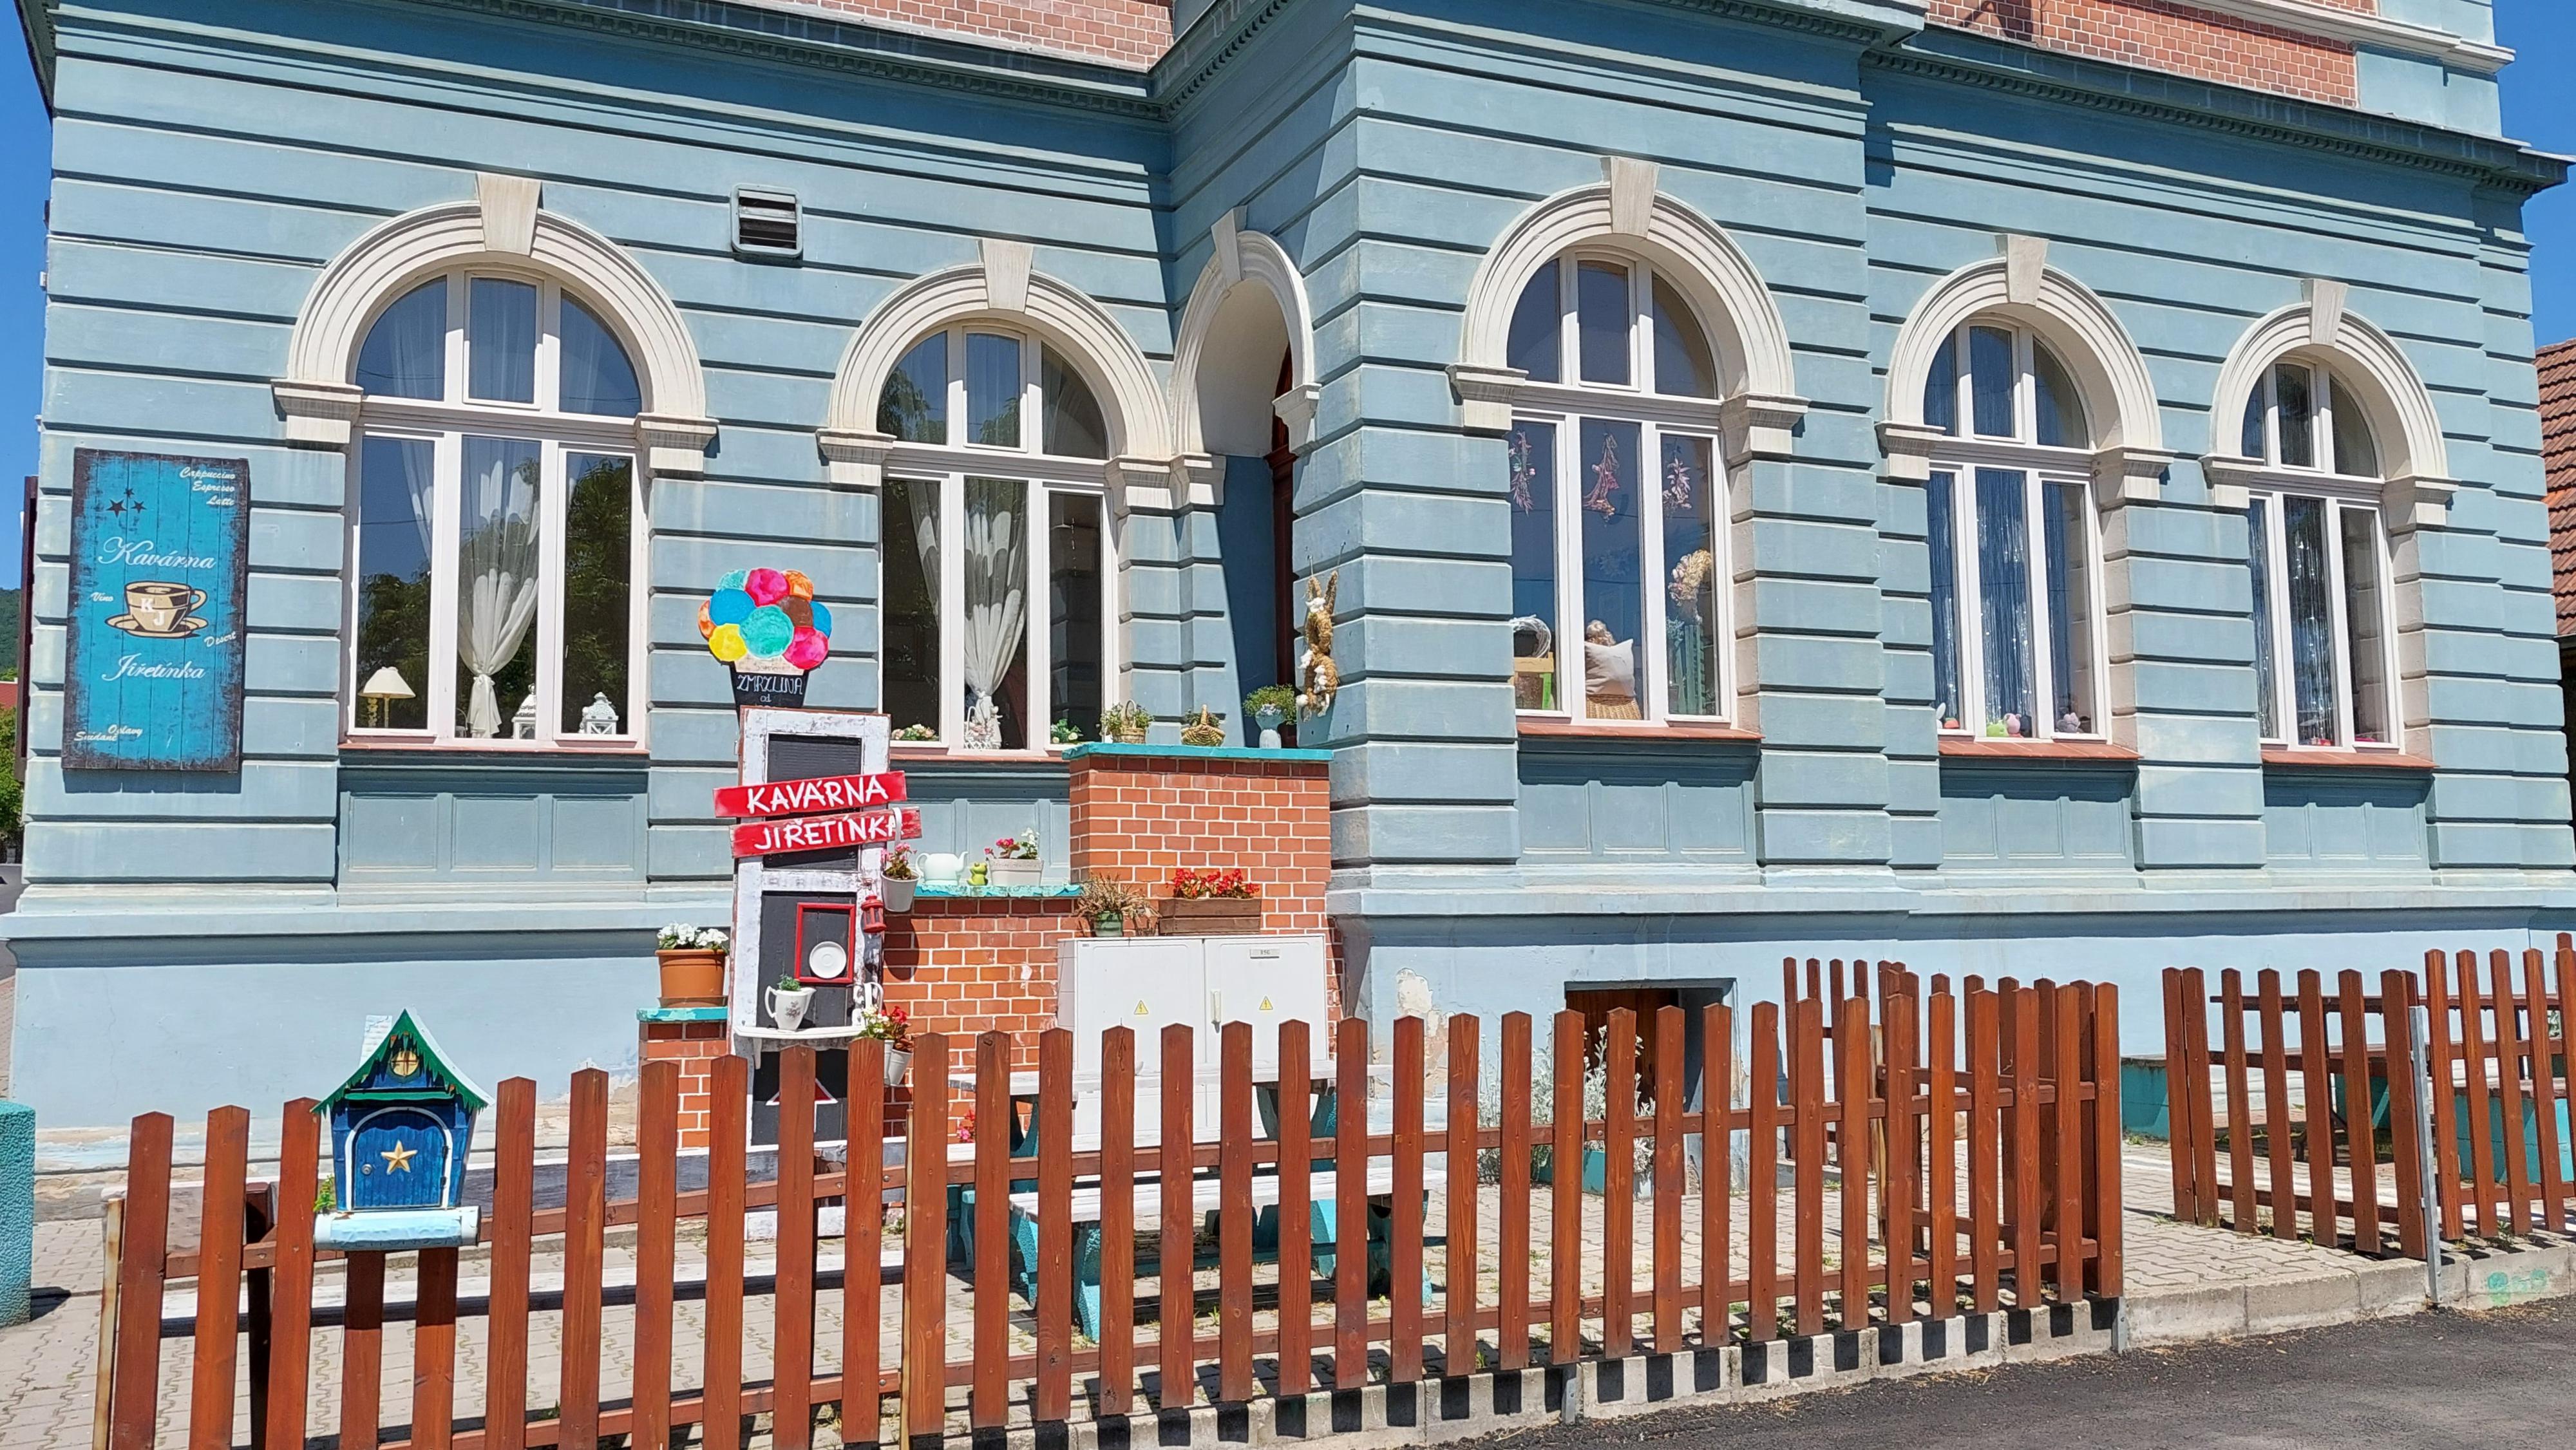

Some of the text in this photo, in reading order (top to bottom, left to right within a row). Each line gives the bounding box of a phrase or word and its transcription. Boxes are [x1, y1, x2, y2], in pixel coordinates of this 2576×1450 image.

[179, 466, 236, 479] Cappuccino
[193, 480, 235, 493] Espresso
[206, 494, 235, 506] Latte
[98, 536, 216, 569] Kavárna
[140, 598, 155, 612] K
[153, 611, 166, 626] J
[102, 652, 205, 681] Jiřetínka
[736, 674, 804, 695] ZMRZLINA
[760, 693, 772, 702] od
[747, 775, 889, 814] KAVÁRNA
